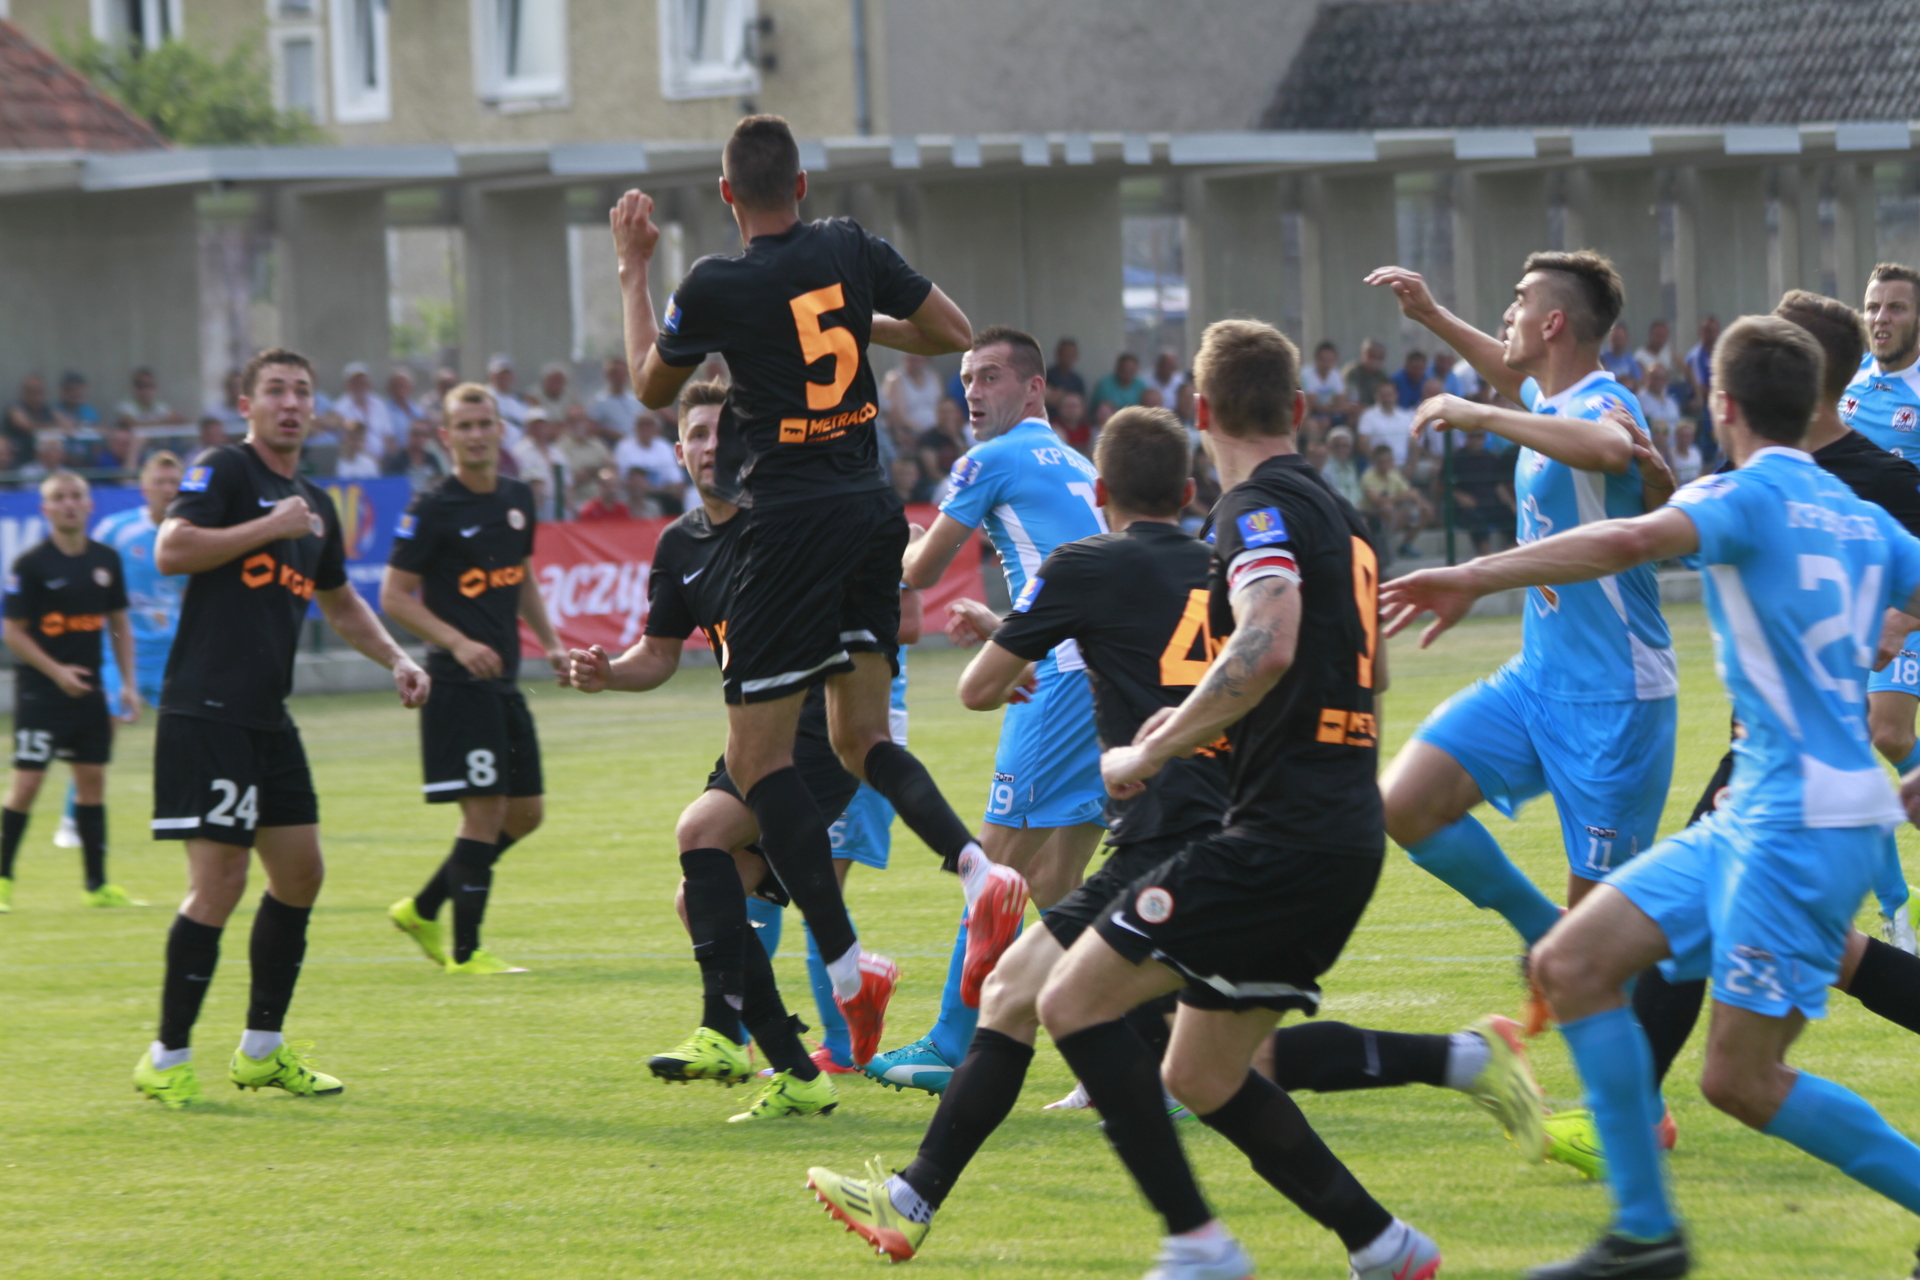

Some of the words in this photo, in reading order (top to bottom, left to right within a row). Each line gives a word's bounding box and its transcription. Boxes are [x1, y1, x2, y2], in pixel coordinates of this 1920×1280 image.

[789, 282, 860, 411] 5
[1031, 447, 1063, 466] KP
[1159, 588, 1212, 687] 4
[1891, 656, 1920, 686] 18
[16, 730, 52, 762] 15
[466, 748, 498, 788] 8
[206, 778, 259, 830] 24
[987, 782, 1014, 815] 19
[1585, 836, 1613, 872] 11
